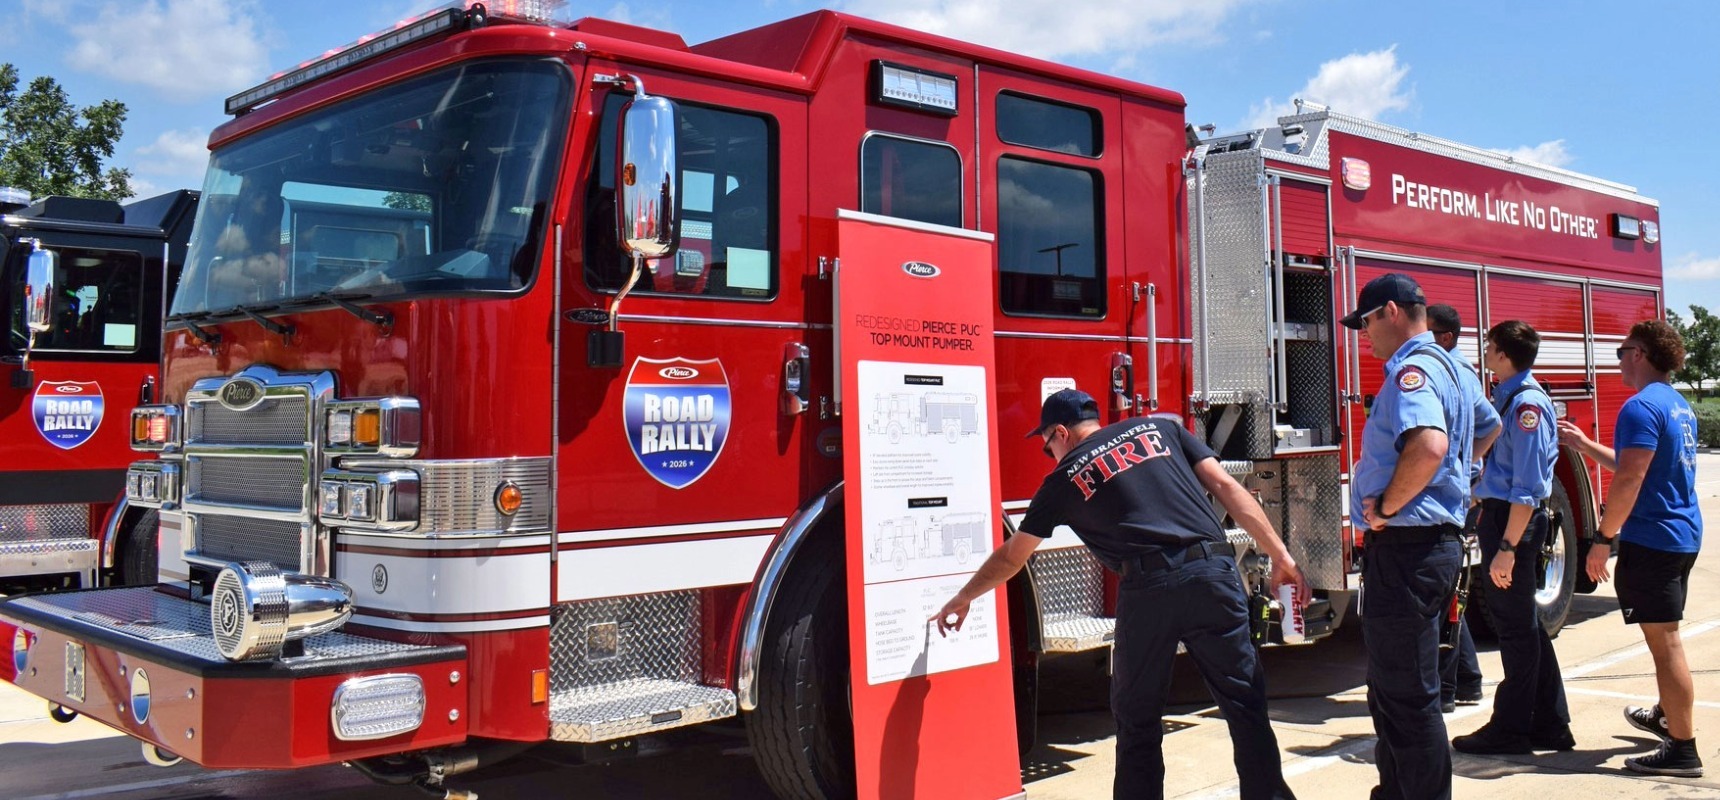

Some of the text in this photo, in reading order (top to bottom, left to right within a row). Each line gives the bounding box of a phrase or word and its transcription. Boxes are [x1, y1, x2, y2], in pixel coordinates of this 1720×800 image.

[1392, 173, 1481, 219] PERFORM.
[1484, 192, 1520, 226] LIKE
[1523, 200, 1546, 230] NO
[909, 262, 932, 274] Pierce
[855, 314, 920, 332] REDESIGNED
[922, 320, 957, 335] PIERCE
[870, 332, 975, 351] TOP MOUNT PUMPER.
[668, 366, 691, 378] Pierce
[226, 383, 252, 401] Pierce
[46, 400, 93, 415] ROAD
[644, 393, 714, 423] ROAD
[43, 415, 94, 432] RALLY
[641, 423, 718, 455] RALLY
[1067, 422, 1157, 478] NEW BRAUNFELS
[669, 460, 687, 468] 2026
[1070, 430, 1171, 502] FIRE
